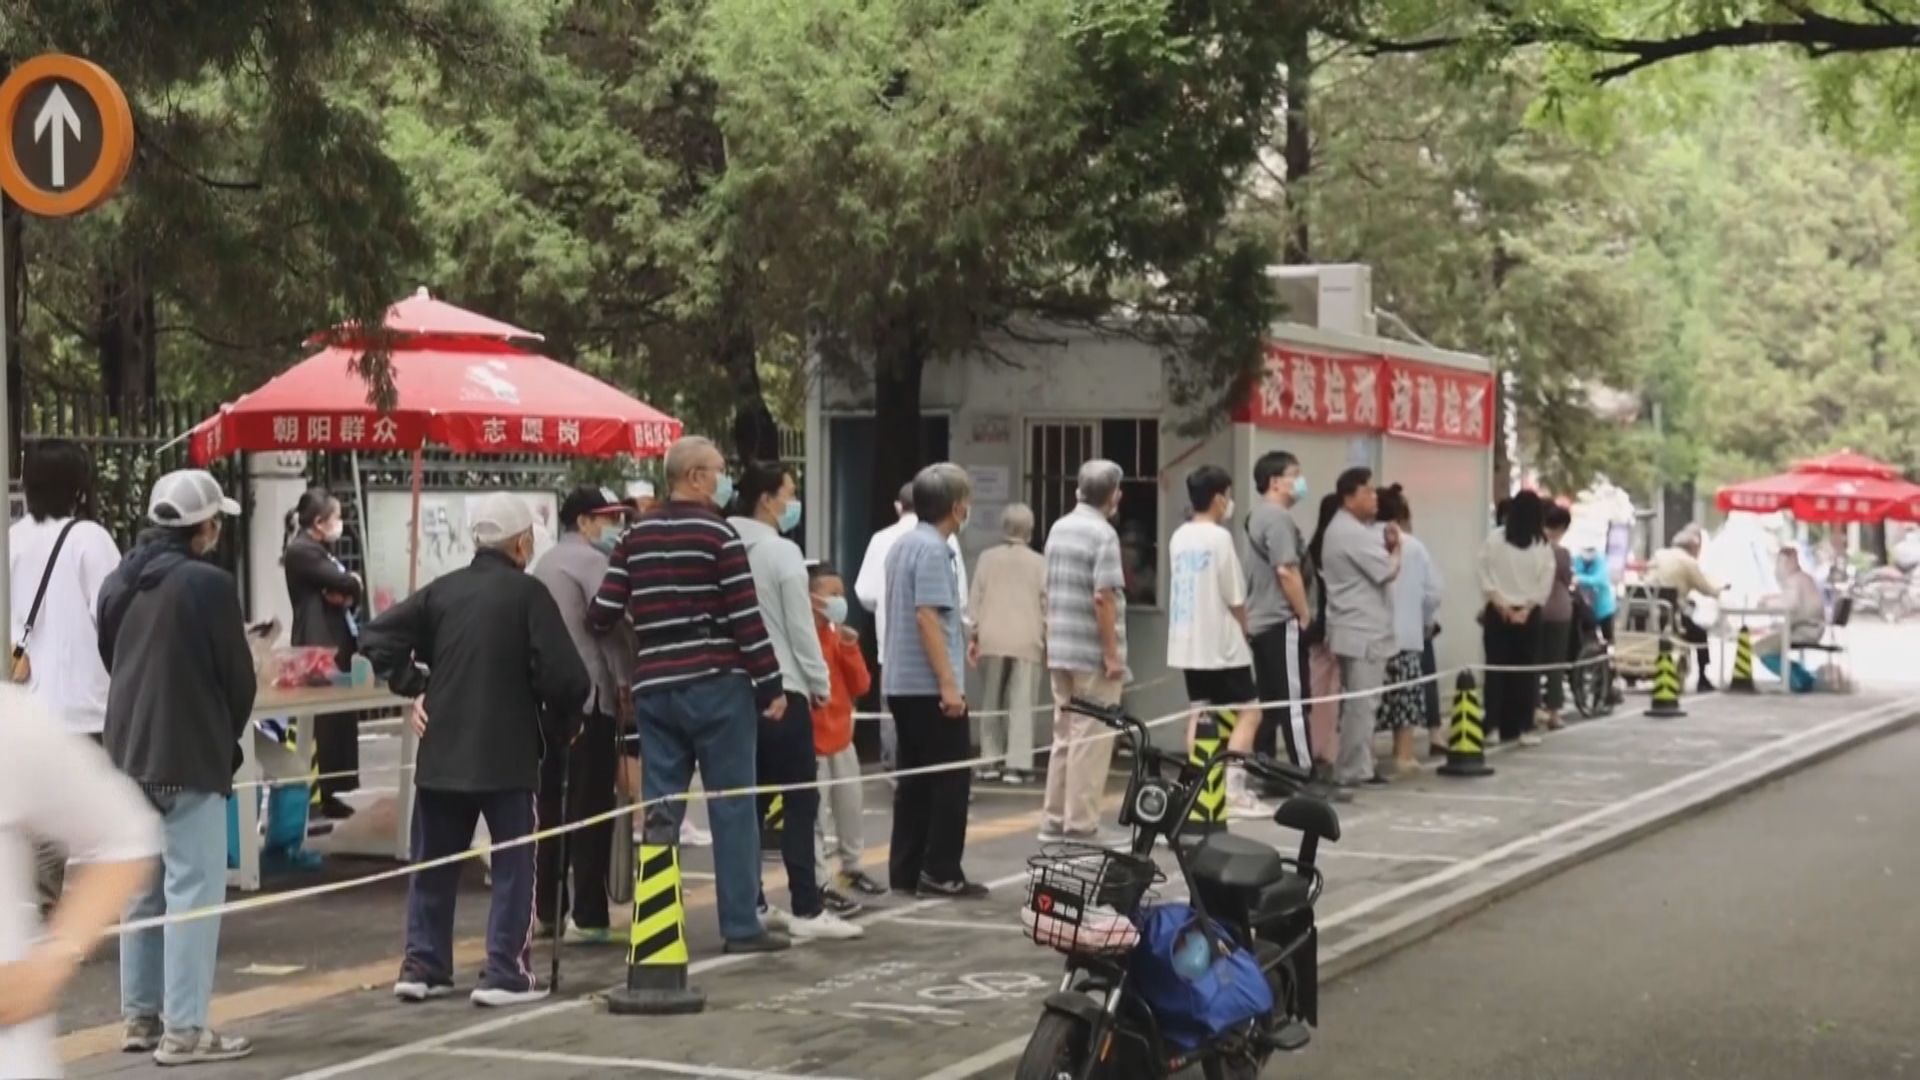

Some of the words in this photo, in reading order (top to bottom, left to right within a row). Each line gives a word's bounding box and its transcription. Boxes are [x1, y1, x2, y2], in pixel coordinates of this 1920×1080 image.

[1260, 354, 1376, 425] 核酸检测
[273, 415, 399, 444] 朝阳群众
[483, 417, 582, 446] 志愿岗
